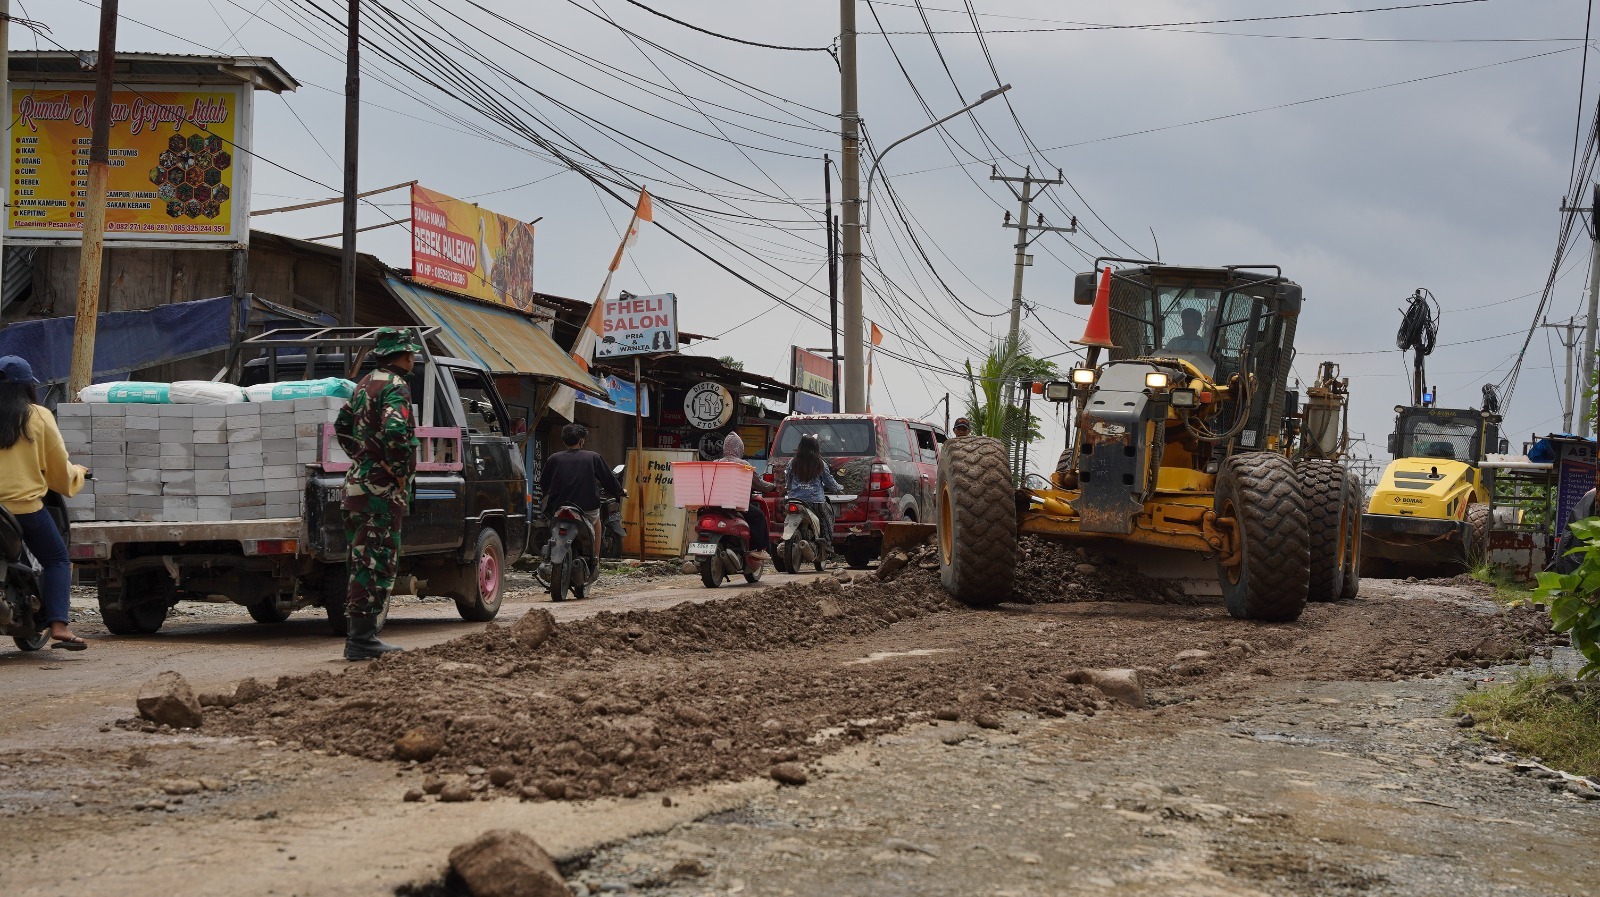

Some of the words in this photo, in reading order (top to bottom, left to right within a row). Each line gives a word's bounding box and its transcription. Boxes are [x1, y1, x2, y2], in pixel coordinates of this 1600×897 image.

[19, 95, 72, 132] Rumah
[73, 95, 129, 131] Man
[131, 97, 187, 134] Goyang
[188, 96, 227, 129] Lidah
[414, 207, 431, 224] RUMAH
[431, 212, 447, 229] MAKAN
[414, 226, 441, 258] BEBEK
[442, 235, 476, 268] PALEKKO
[416, 262, 424, 274] NO
[424, 264, 432, 276] HP
[606, 299, 663, 316] FHELI
[603, 315, 669, 332] SALON
[619, 344, 651, 352] WANITA
[693, 382, 720, 393] DISTRO
[696, 418, 723, 429] STORE
[648, 460, 671, 471] Fheli
[655, 472, 674, 485] Hou
